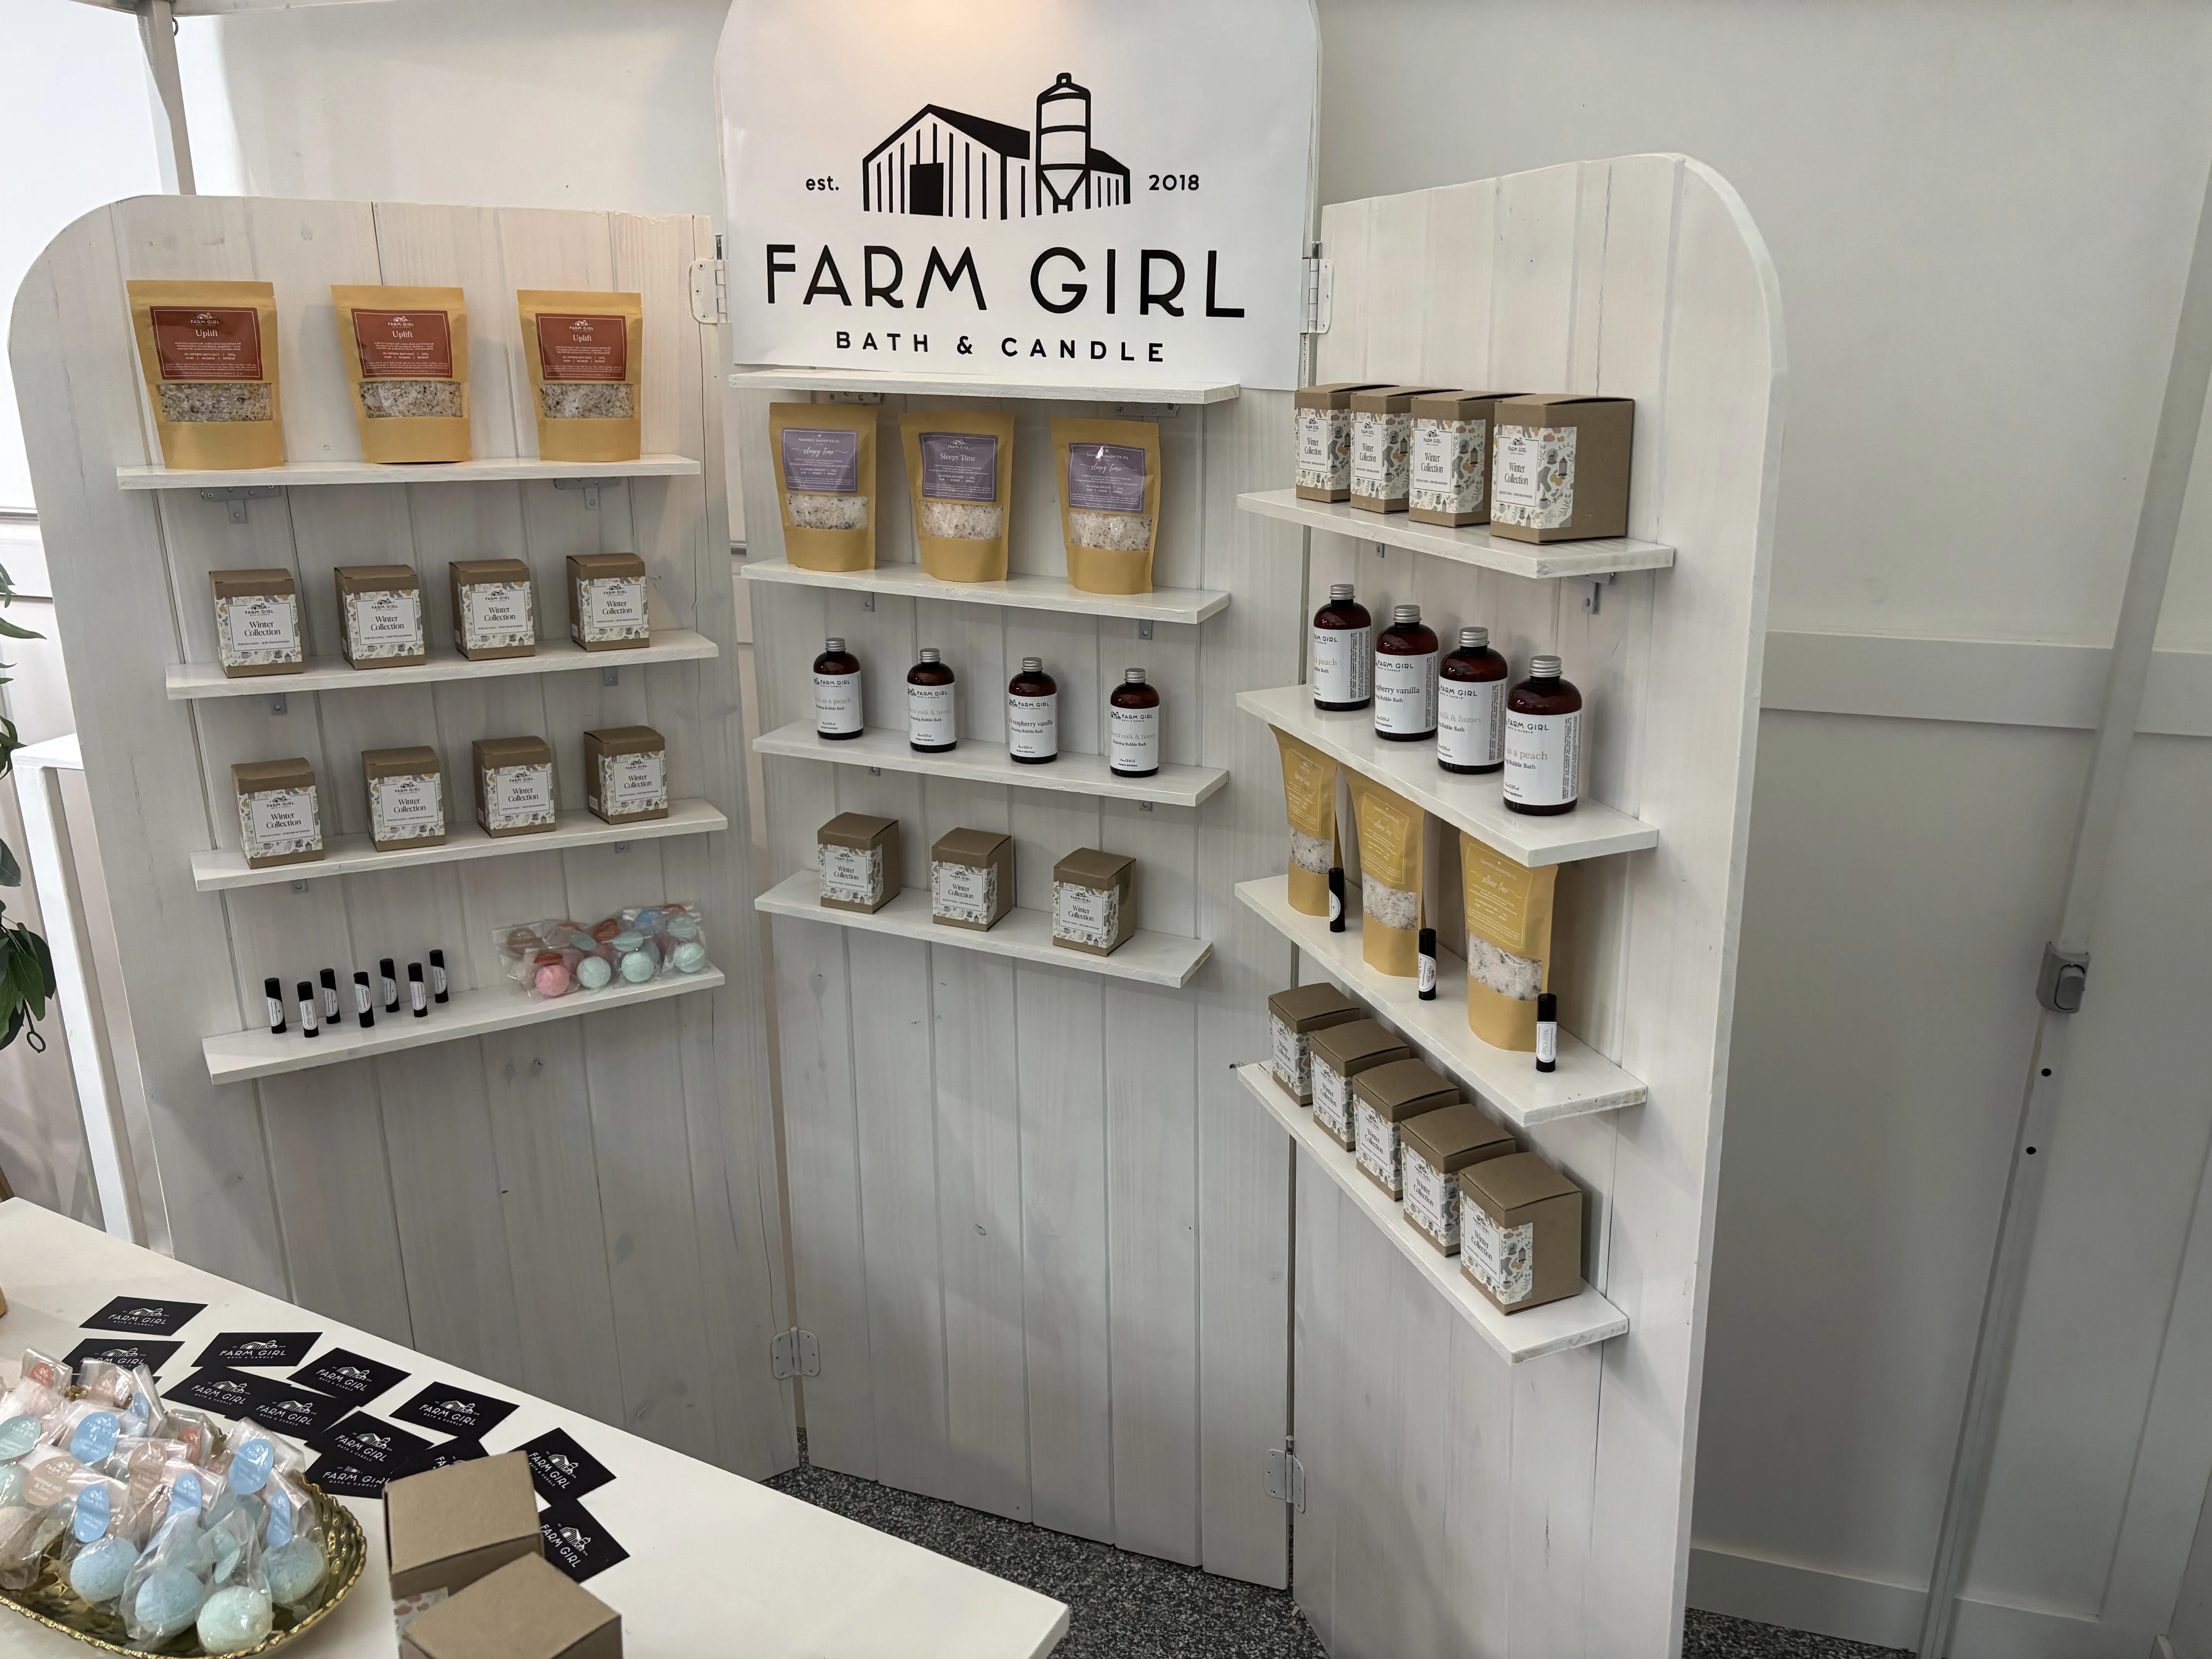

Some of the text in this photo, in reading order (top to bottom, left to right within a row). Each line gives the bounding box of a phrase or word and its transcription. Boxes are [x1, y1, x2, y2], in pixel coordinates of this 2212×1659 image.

[805, 174, 840, 191] est.
[1148, 174, 1199, 191] 2018
[766, 245, 1245, 318] FARM GIRL
[196, 330, 218, 338] Uplift
[836, 331, 1163, 362] BATH & CANDLE
[1307, 438, 1319, 446] Winter
[1362, 443, 1374, 452] Winter
[1305, 447, 1321, 456] Collection
[1360, 452, 1376, 462] Collection
[1425, 452, 1440, 462] Winter
[940, 453, 959, 462] Sleepy
[1421, 462, 1443, 473] Collection
[1510, 462, 1525, 473] Winter
[1505, 473, 1528, 485] Collection
[1440, 685, 1455, 694] FARM
[1458, 715, 1483, 723] honey
[1508, 718, 1524, 729] FARM
[1520, 751, 1547, 760] peach
[1509, 759, 1522, 768] Bubble
[266, 820, 301, 829] Collection
[834, 871, 859, 880] Collection
[948, 889, 974, 899] Collection
[1073, 905, 1090, 914] Winter
[1068, 911, 1094, 922] Collection
[1367, 1128, 1380, 1143] Winter
[1365, 1133, 1383, 1154] Collection
[1417, 1178, 1430, 1195] Winter
[1413, 1184, 1434, 1207] Collection
[1475, 1230, 1489, 1249] Winter
[1472, 1236, 1492, 1261] Collection
[316, 1369, 368, 1391] FARM GIRL
[191, 1385, 246, 1404] FARM GIRL
[256, 1405, 311, 1425] FARM GIRL
[419, 1405, 476, 1425] FARM GIRL
[335, 1435, 388, 1462] FARM GIRL
[529, 1452, 570, 1489] FARM GIRL
[323, 1472, 357, 1481] FARM
[541, 1524, 580, 1568] FARM GIRL
